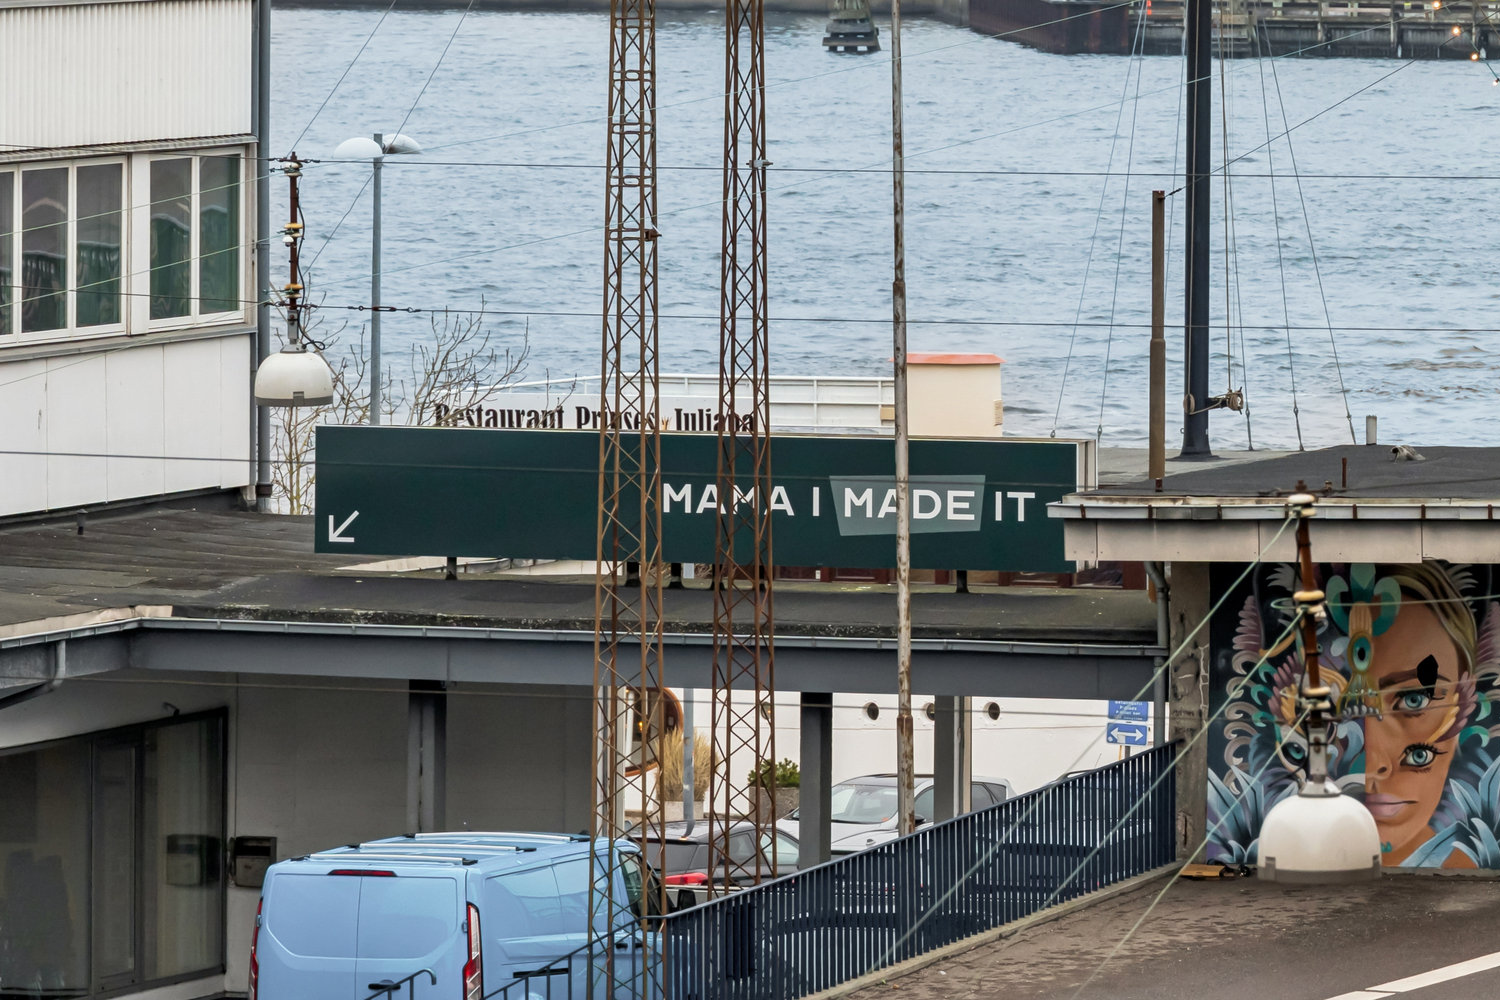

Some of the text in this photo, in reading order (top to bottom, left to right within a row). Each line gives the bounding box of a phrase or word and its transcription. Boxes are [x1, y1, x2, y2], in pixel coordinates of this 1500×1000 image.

[663, 483, 1036, 522] MAMA I MADE IT
